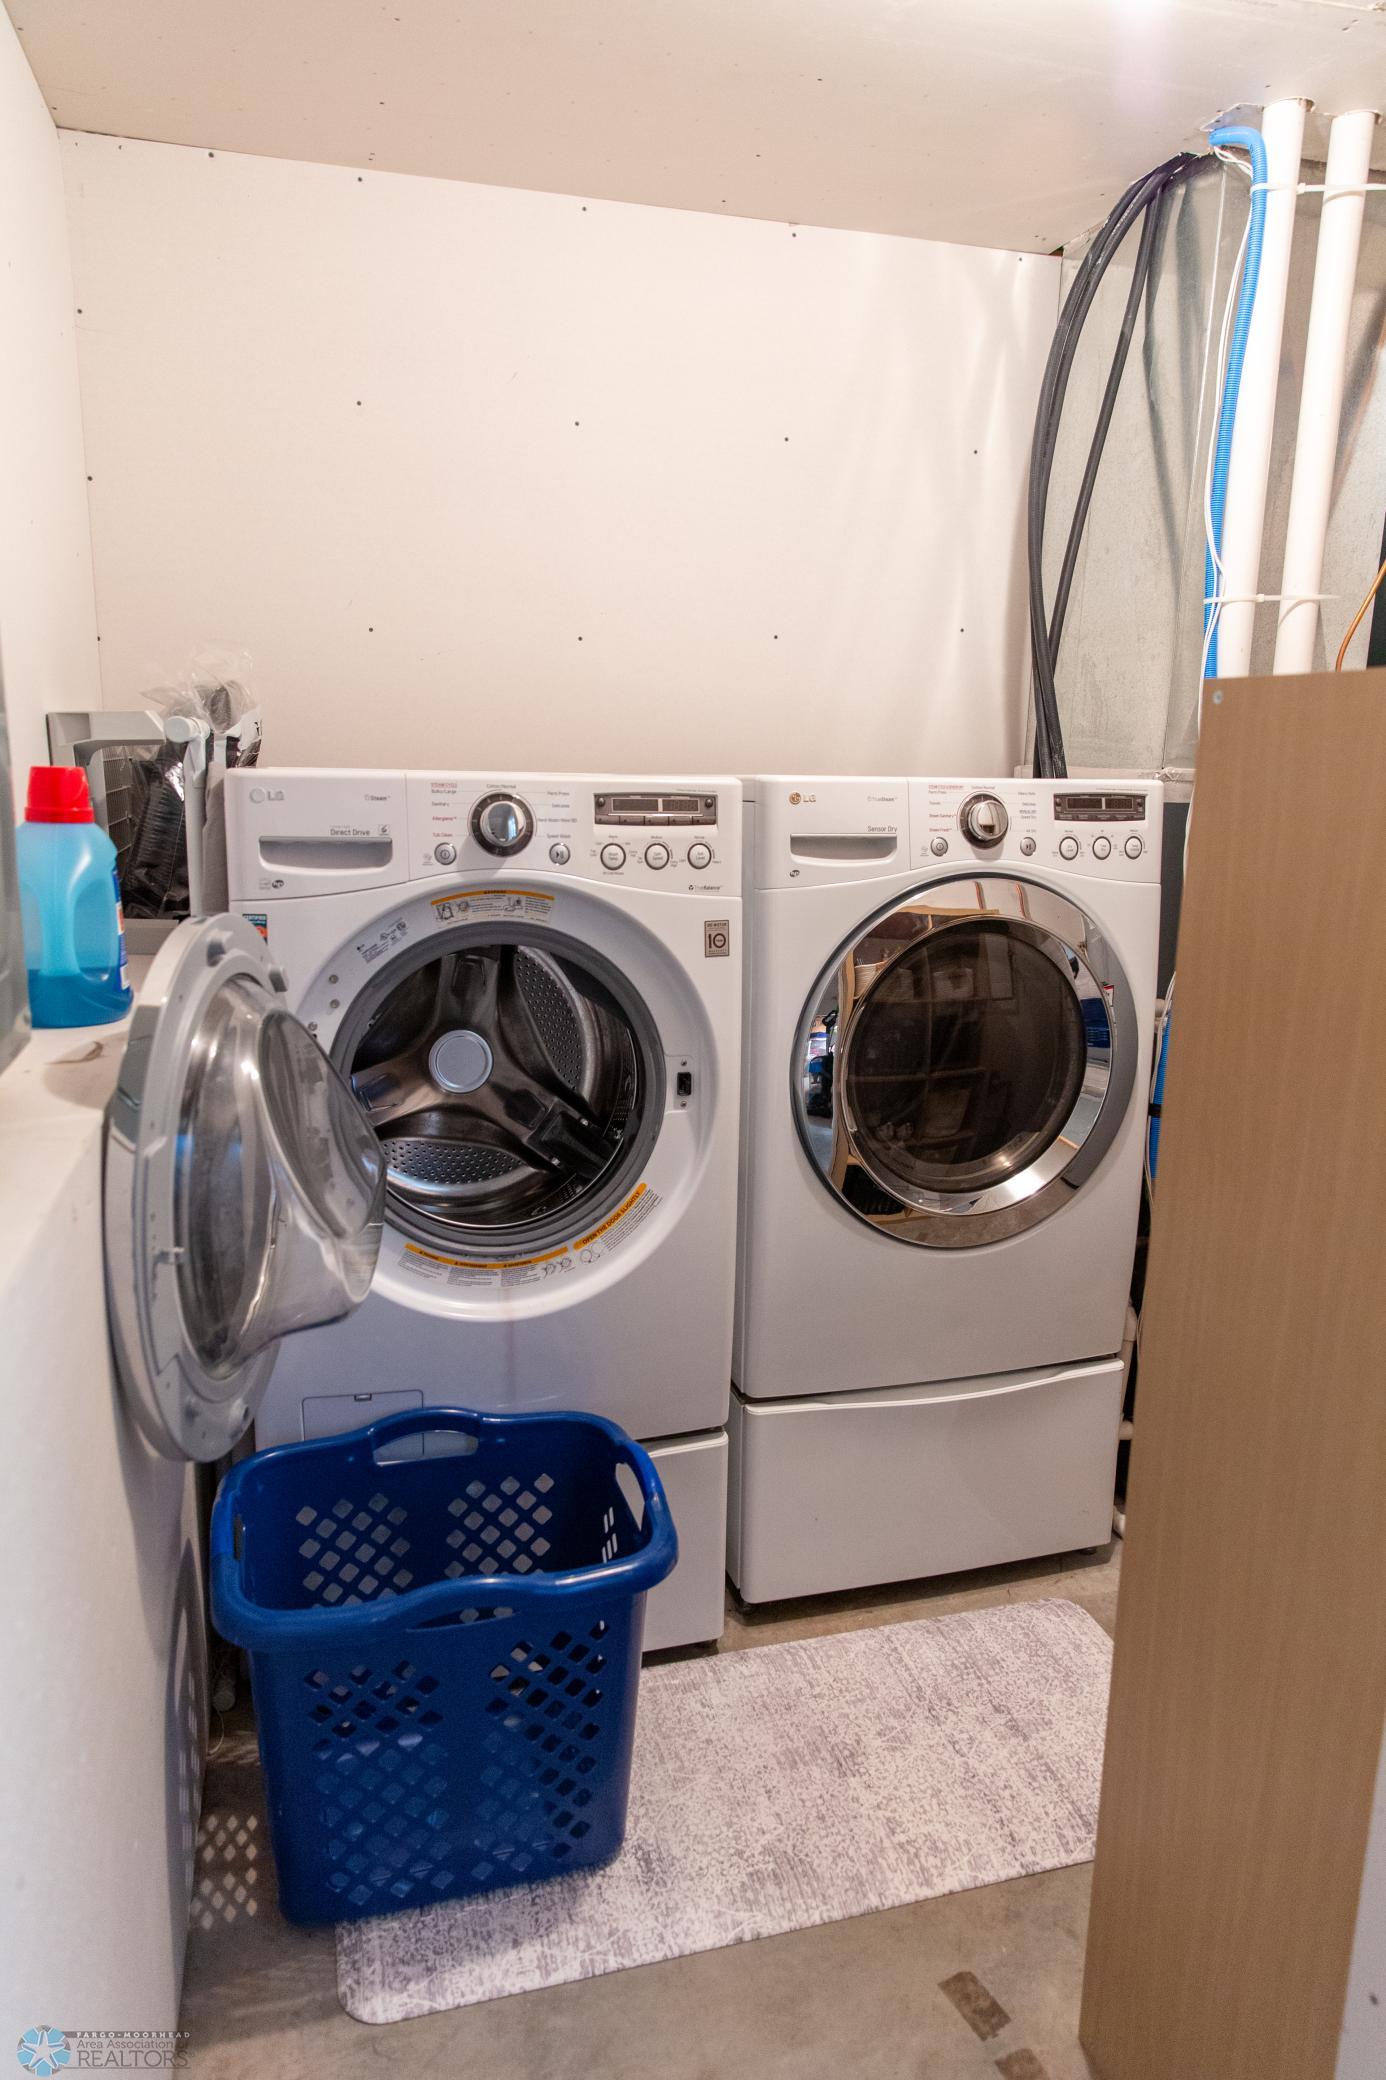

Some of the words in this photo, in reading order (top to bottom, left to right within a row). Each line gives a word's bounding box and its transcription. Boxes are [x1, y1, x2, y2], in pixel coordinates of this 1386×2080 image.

[267, 790, 285, 801] LG
[803, 794, 817, 803] LG
[330, 828, 351, 836] Direct
[352, 828, 371, 836] Drive
[708, 933, 727, 949] 10
